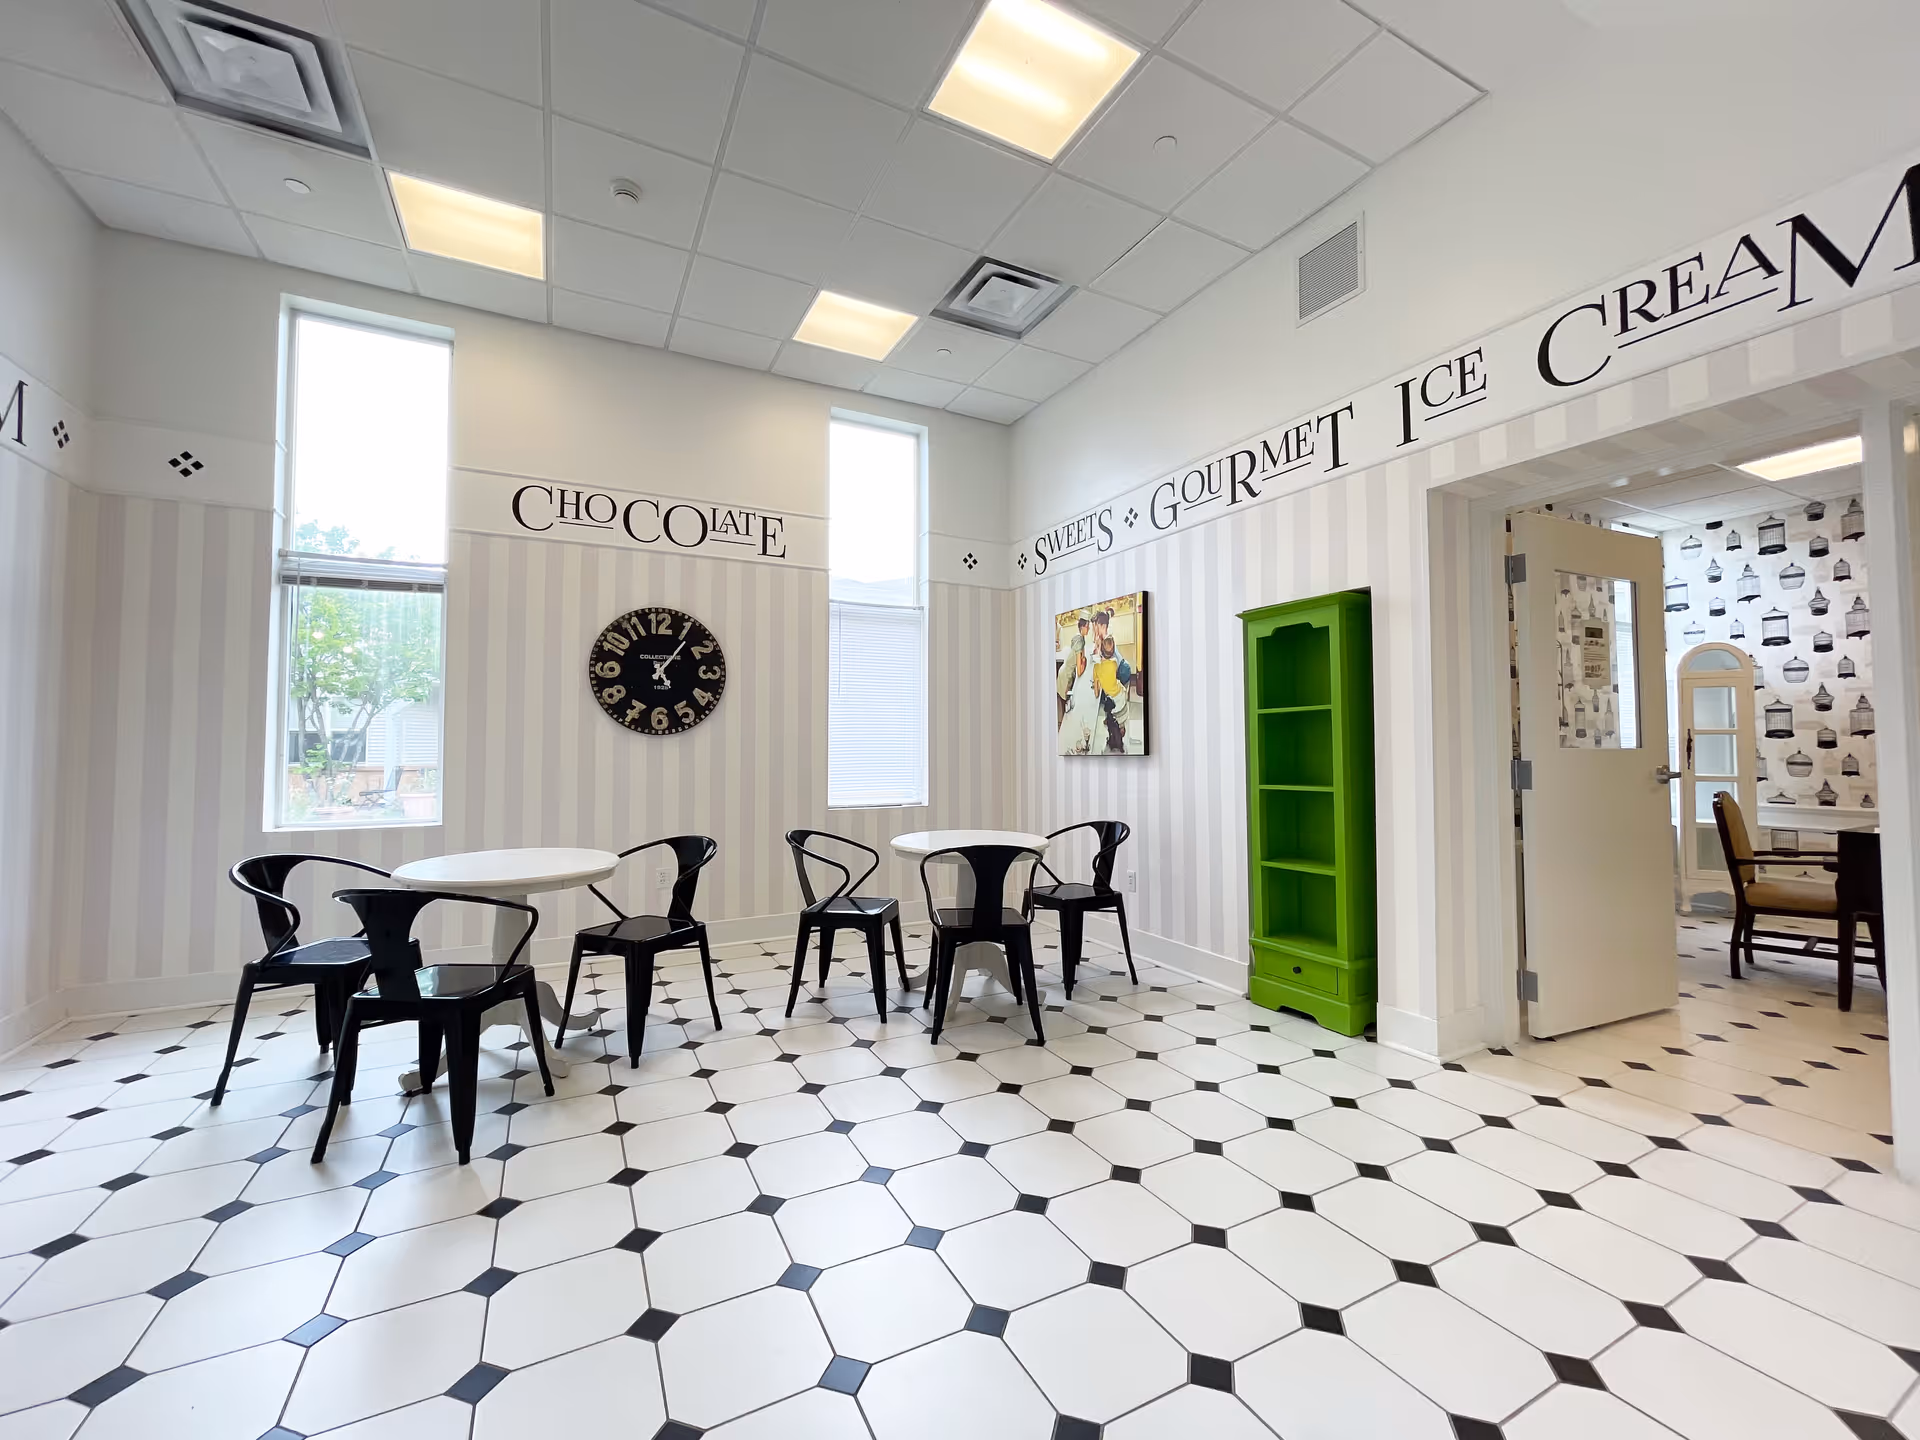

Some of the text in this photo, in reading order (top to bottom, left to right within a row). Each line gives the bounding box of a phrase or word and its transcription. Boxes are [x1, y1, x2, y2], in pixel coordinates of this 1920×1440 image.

[1034, 163, 1920, 577] SWEETS GOURMET ICE CREAM
[511, 485, 787, 559] CHOCOLATE
[621, 616, 647, 641] 11
[648, 612, 673, 635] 12
[678, 621, 692, 641] 1
[602, 631, 630, 656] 10
[691, 640, 714, 660] 2
[595, 660, 621, 679] 9
[698, 665, 721, 680] 3
[602, 684, 627, 705] 8
[692, 687, 715, 707] 4
[624, 699, 648, 722] 7
[650, 706, 669, 730] 6
[674, 700, 696, 723] 5
